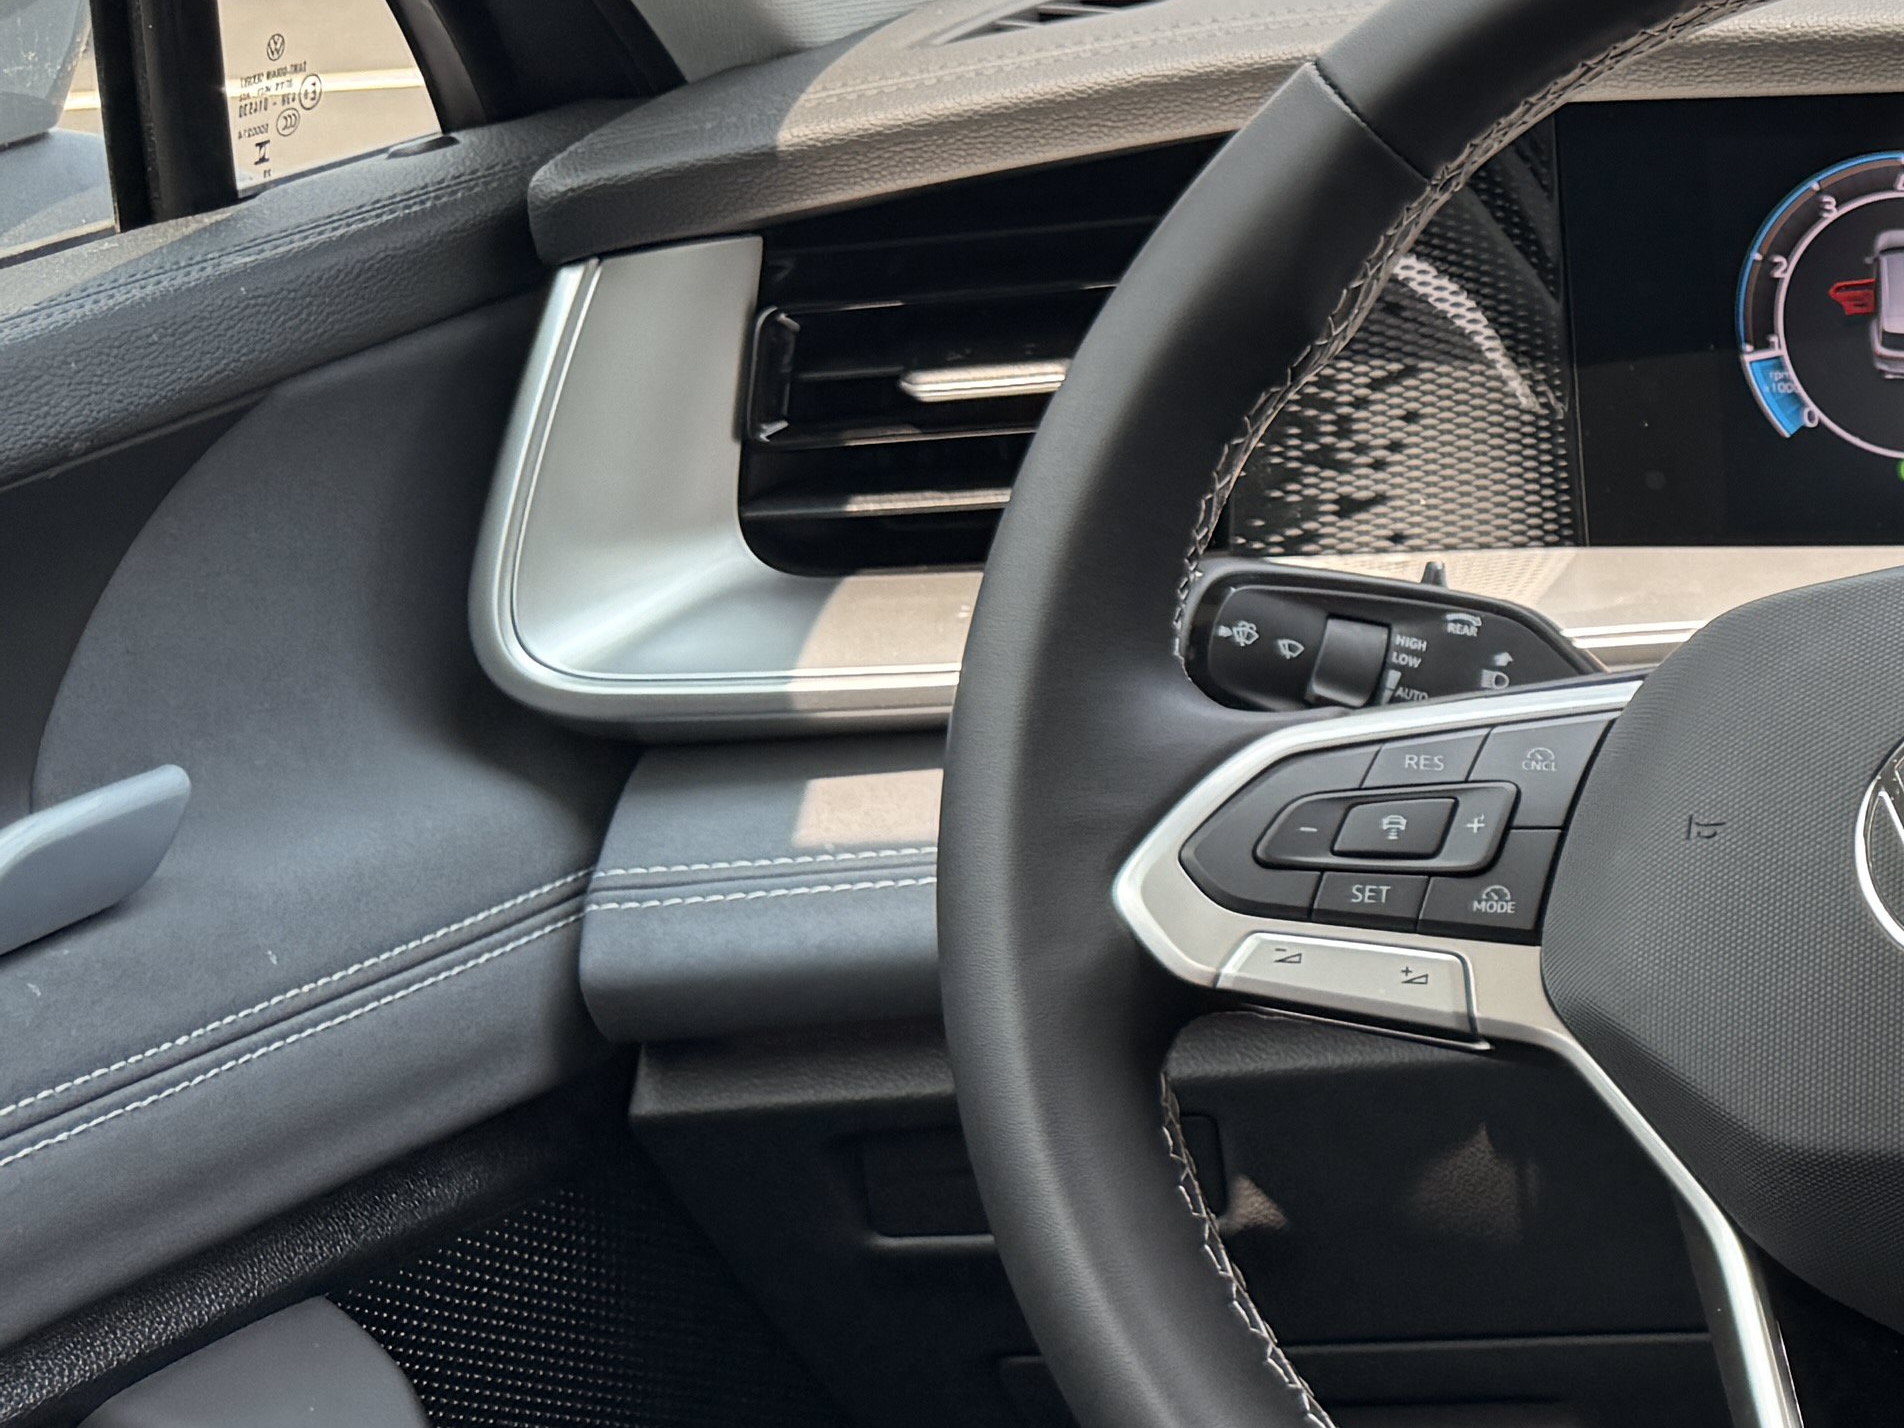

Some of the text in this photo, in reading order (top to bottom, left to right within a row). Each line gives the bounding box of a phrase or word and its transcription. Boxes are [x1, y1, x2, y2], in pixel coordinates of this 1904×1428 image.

[1820, 196, 1837, 219] 3
[1771, 256, 1788, 278] 2
[1803, 406, 1820, 429] 0
[1446, 623, 1478, 637] REAR
[1395, 635, 1427, 653] HIGH
[1392, 653, 1422, 669] LOW
[1395, 687, 1429, 701] AUTO
[1404, 754, 1445, 771] RES
[1350, 884, 1392, 903] SET
[1472, 899, 1516, 914] MODE
